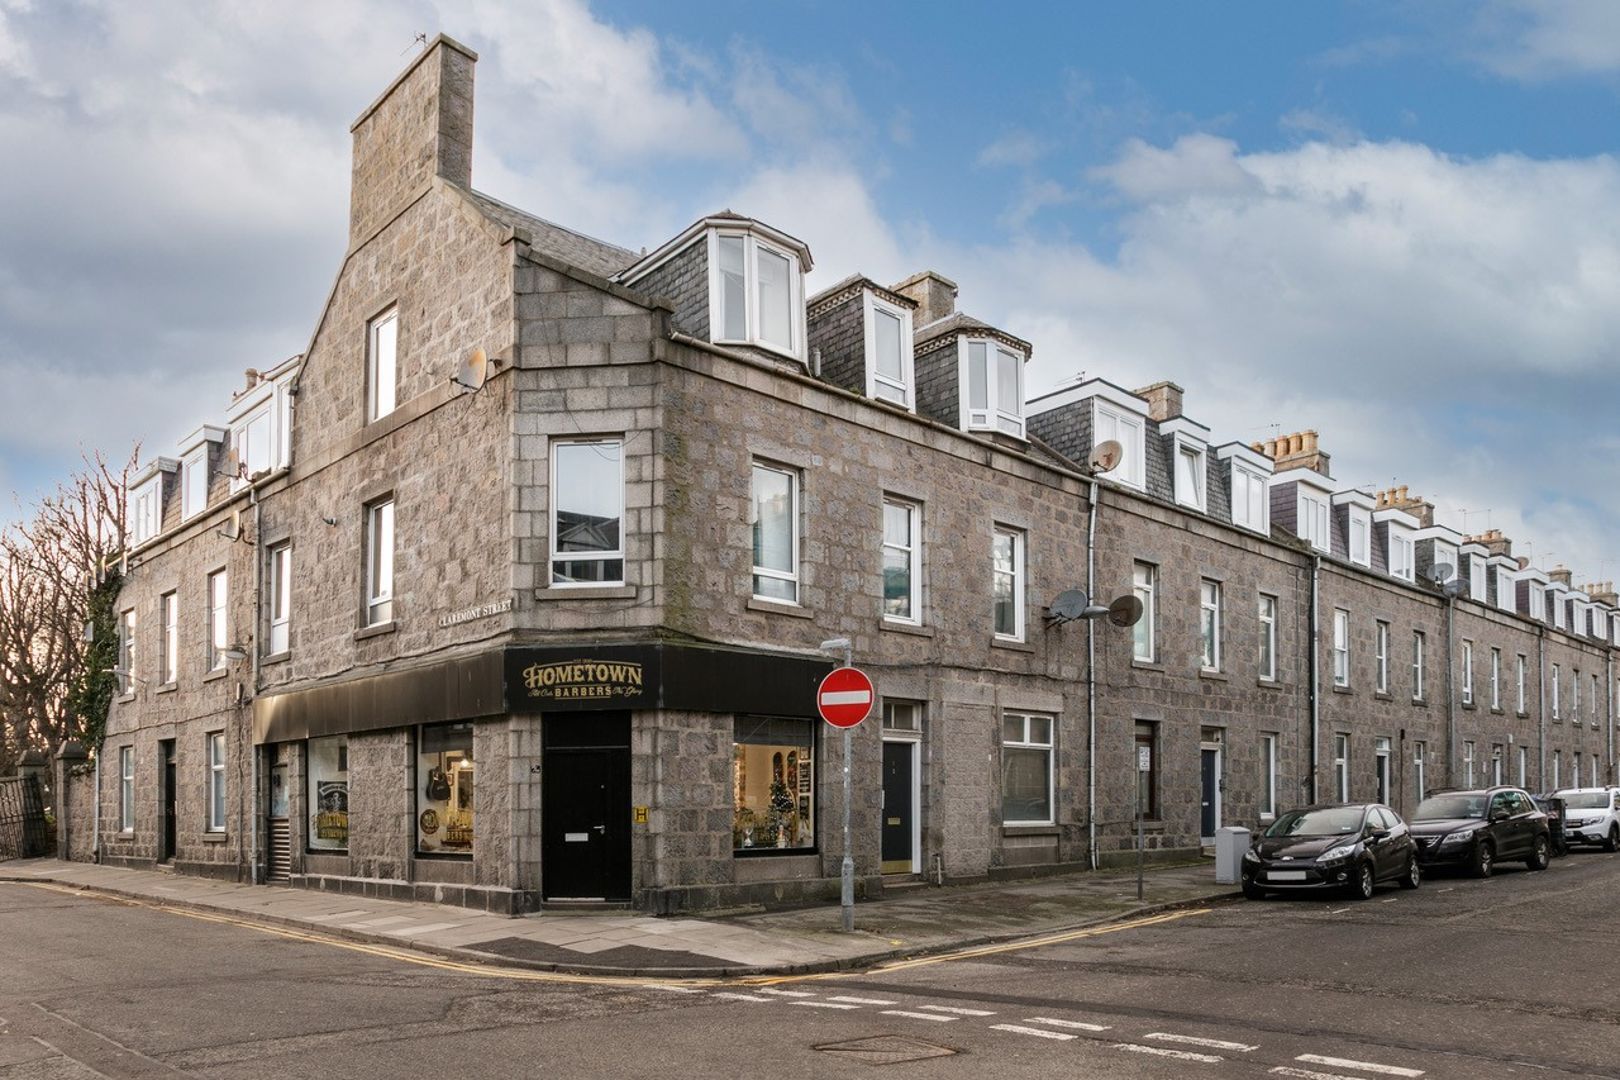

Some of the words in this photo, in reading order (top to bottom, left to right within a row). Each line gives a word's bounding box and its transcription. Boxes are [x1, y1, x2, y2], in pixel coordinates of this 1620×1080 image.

[483, 599, 512, 616] STREET
[522, 662, 643, 690] HOMETOWN
[555, 686, 611, 697] BARBERS
[636, 808, 647, 821] H
